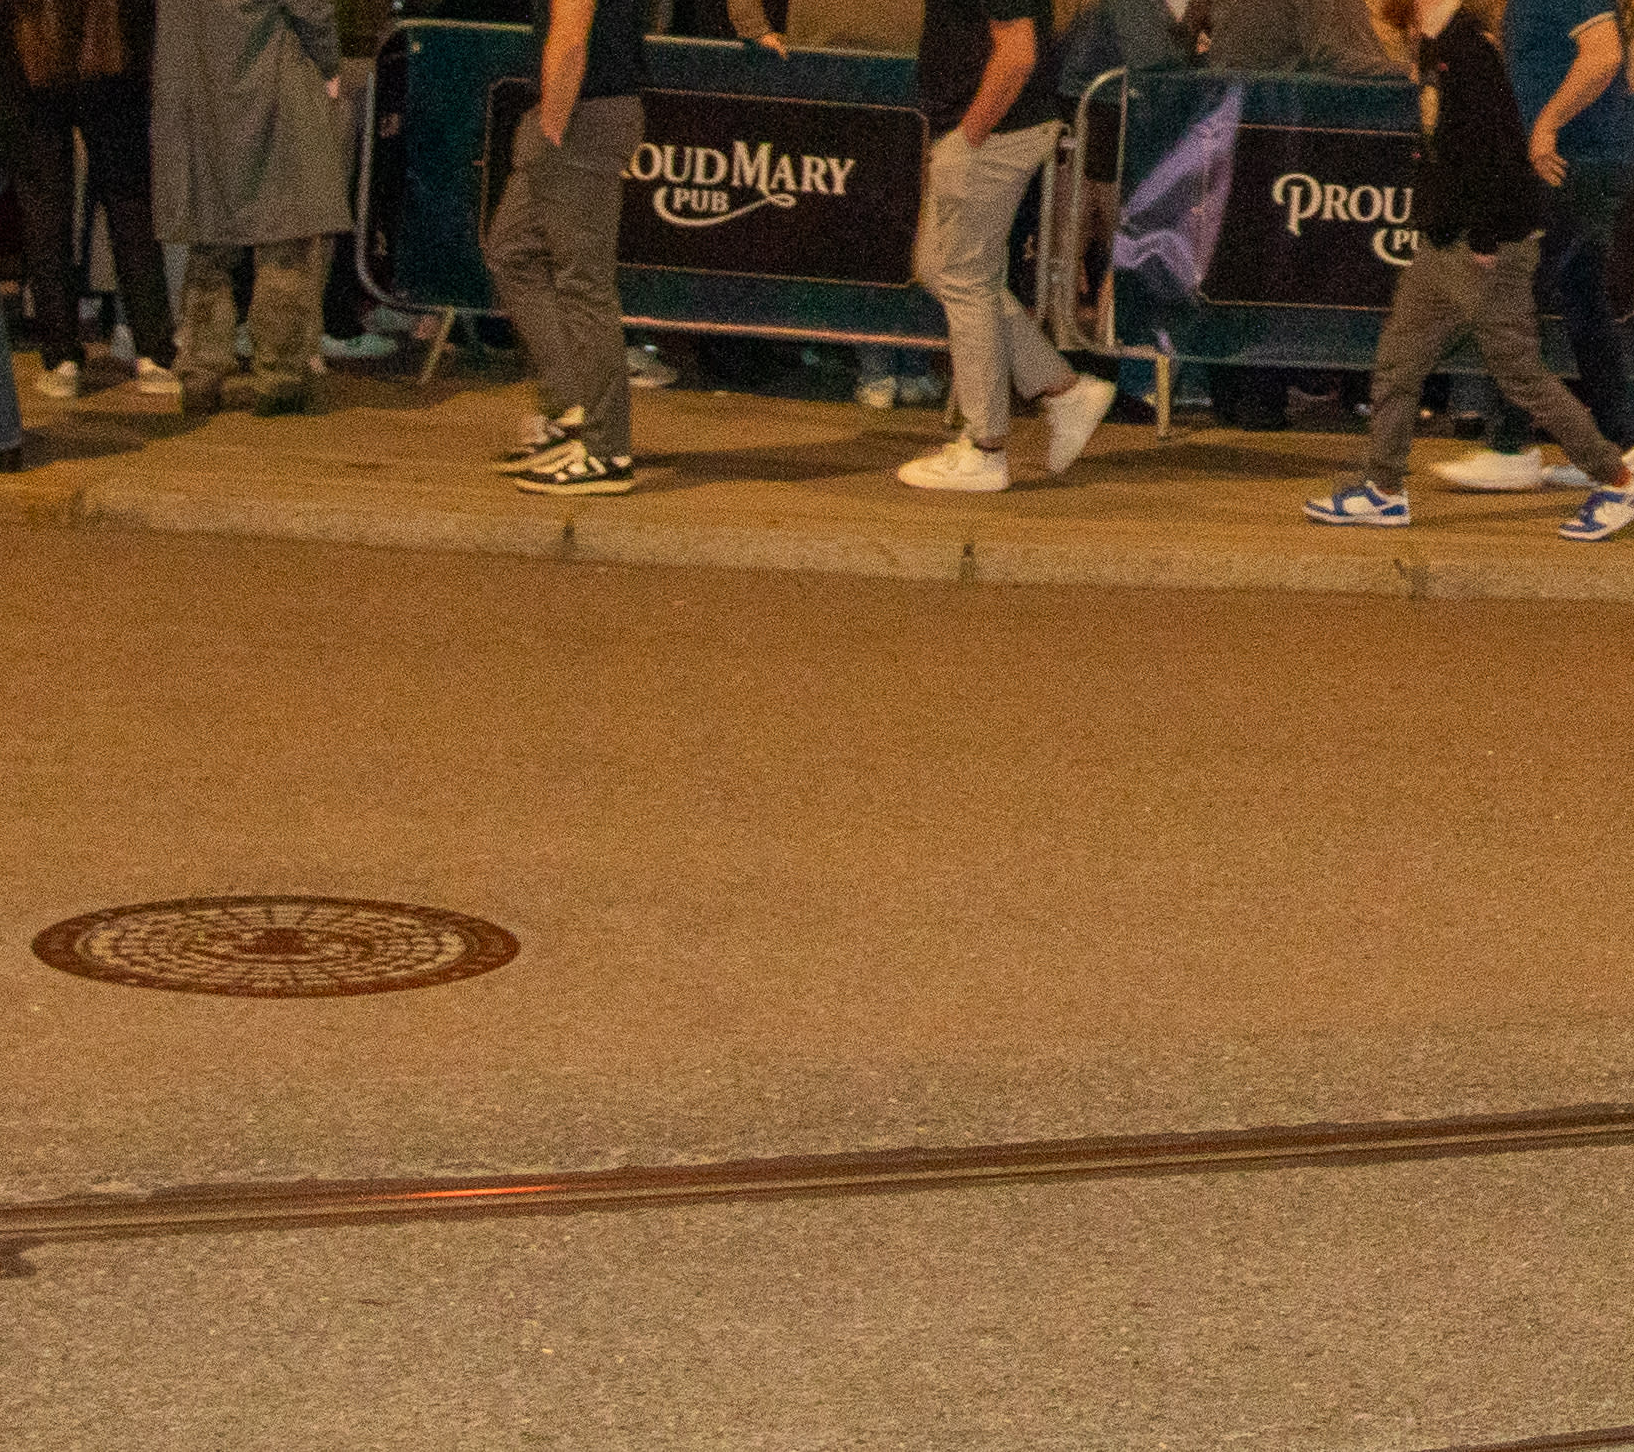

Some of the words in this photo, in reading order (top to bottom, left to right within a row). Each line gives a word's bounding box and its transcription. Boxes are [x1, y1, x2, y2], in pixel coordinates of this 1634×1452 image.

[622, 142, 729, 186] OUD
[730, 140, 856, 196] MARY
[672, 187, 730, 213] PUB
[1271, 172, 1415, 236] PROU
